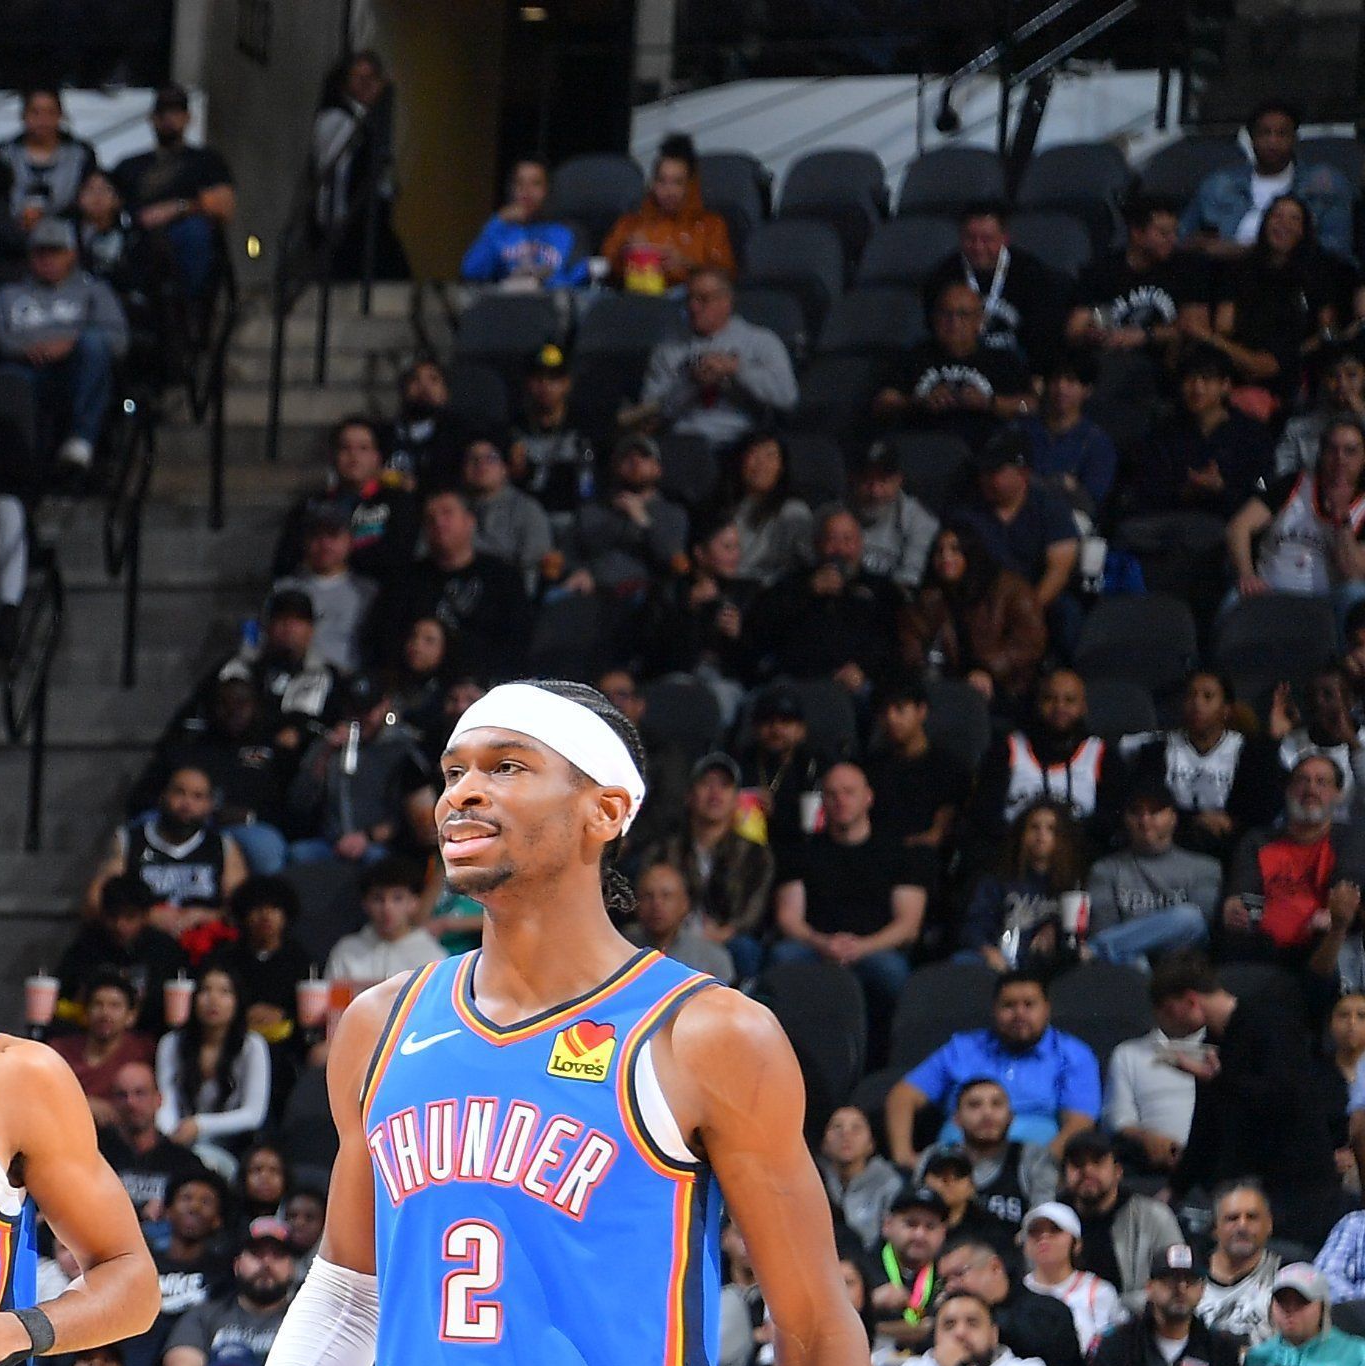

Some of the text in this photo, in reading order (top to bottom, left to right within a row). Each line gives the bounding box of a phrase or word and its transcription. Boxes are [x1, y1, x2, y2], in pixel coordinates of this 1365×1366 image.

[551, 1056, 604, 1077] Love's
[369, 1095, 618, 1222] THUNDER
[439, 1218, 504, 1344] 2
